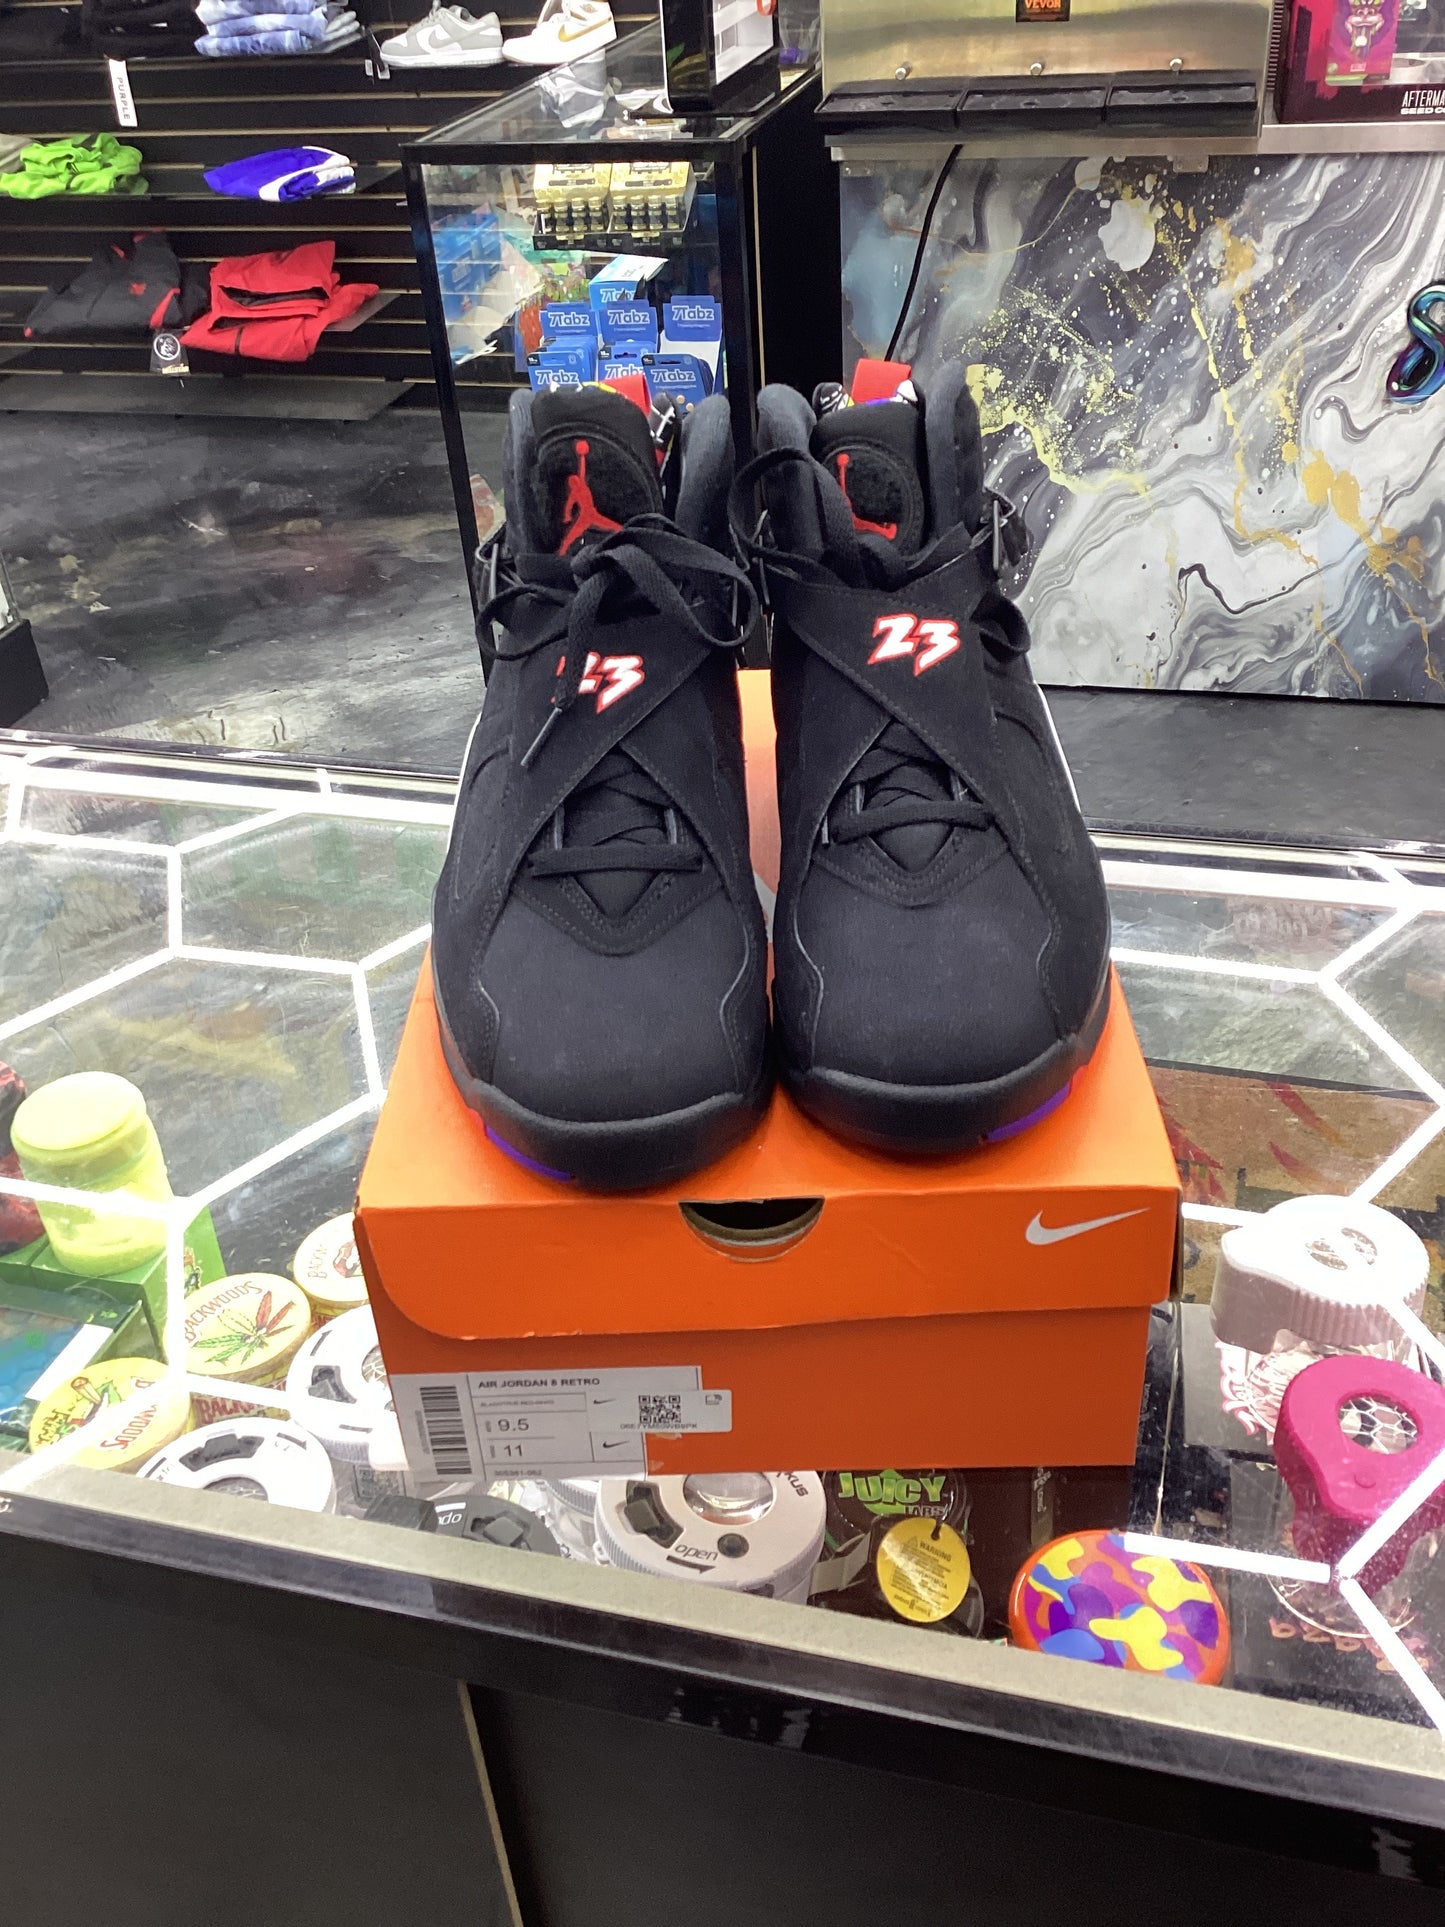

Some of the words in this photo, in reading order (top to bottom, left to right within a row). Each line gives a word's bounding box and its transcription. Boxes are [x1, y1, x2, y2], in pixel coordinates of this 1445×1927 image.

[116, 76, 131, 120] PURPLE
[1400, 107, 1434, 115] SEED
[867, 612, 961, 677] 23
[478, 1380, 498, 1389] AIR
[501, 1378, 548, 1388] JORDAN
[550, 1378, 558, 1387] 8
[560, 1377, 600, 1387] RETRO
[497, 1418, 530, 1432] 9.5
[503, 1444, 523, 1457] 11
[838, 1472, 947, 1503] JUICY
[674, 1543, 719, 1561] open
